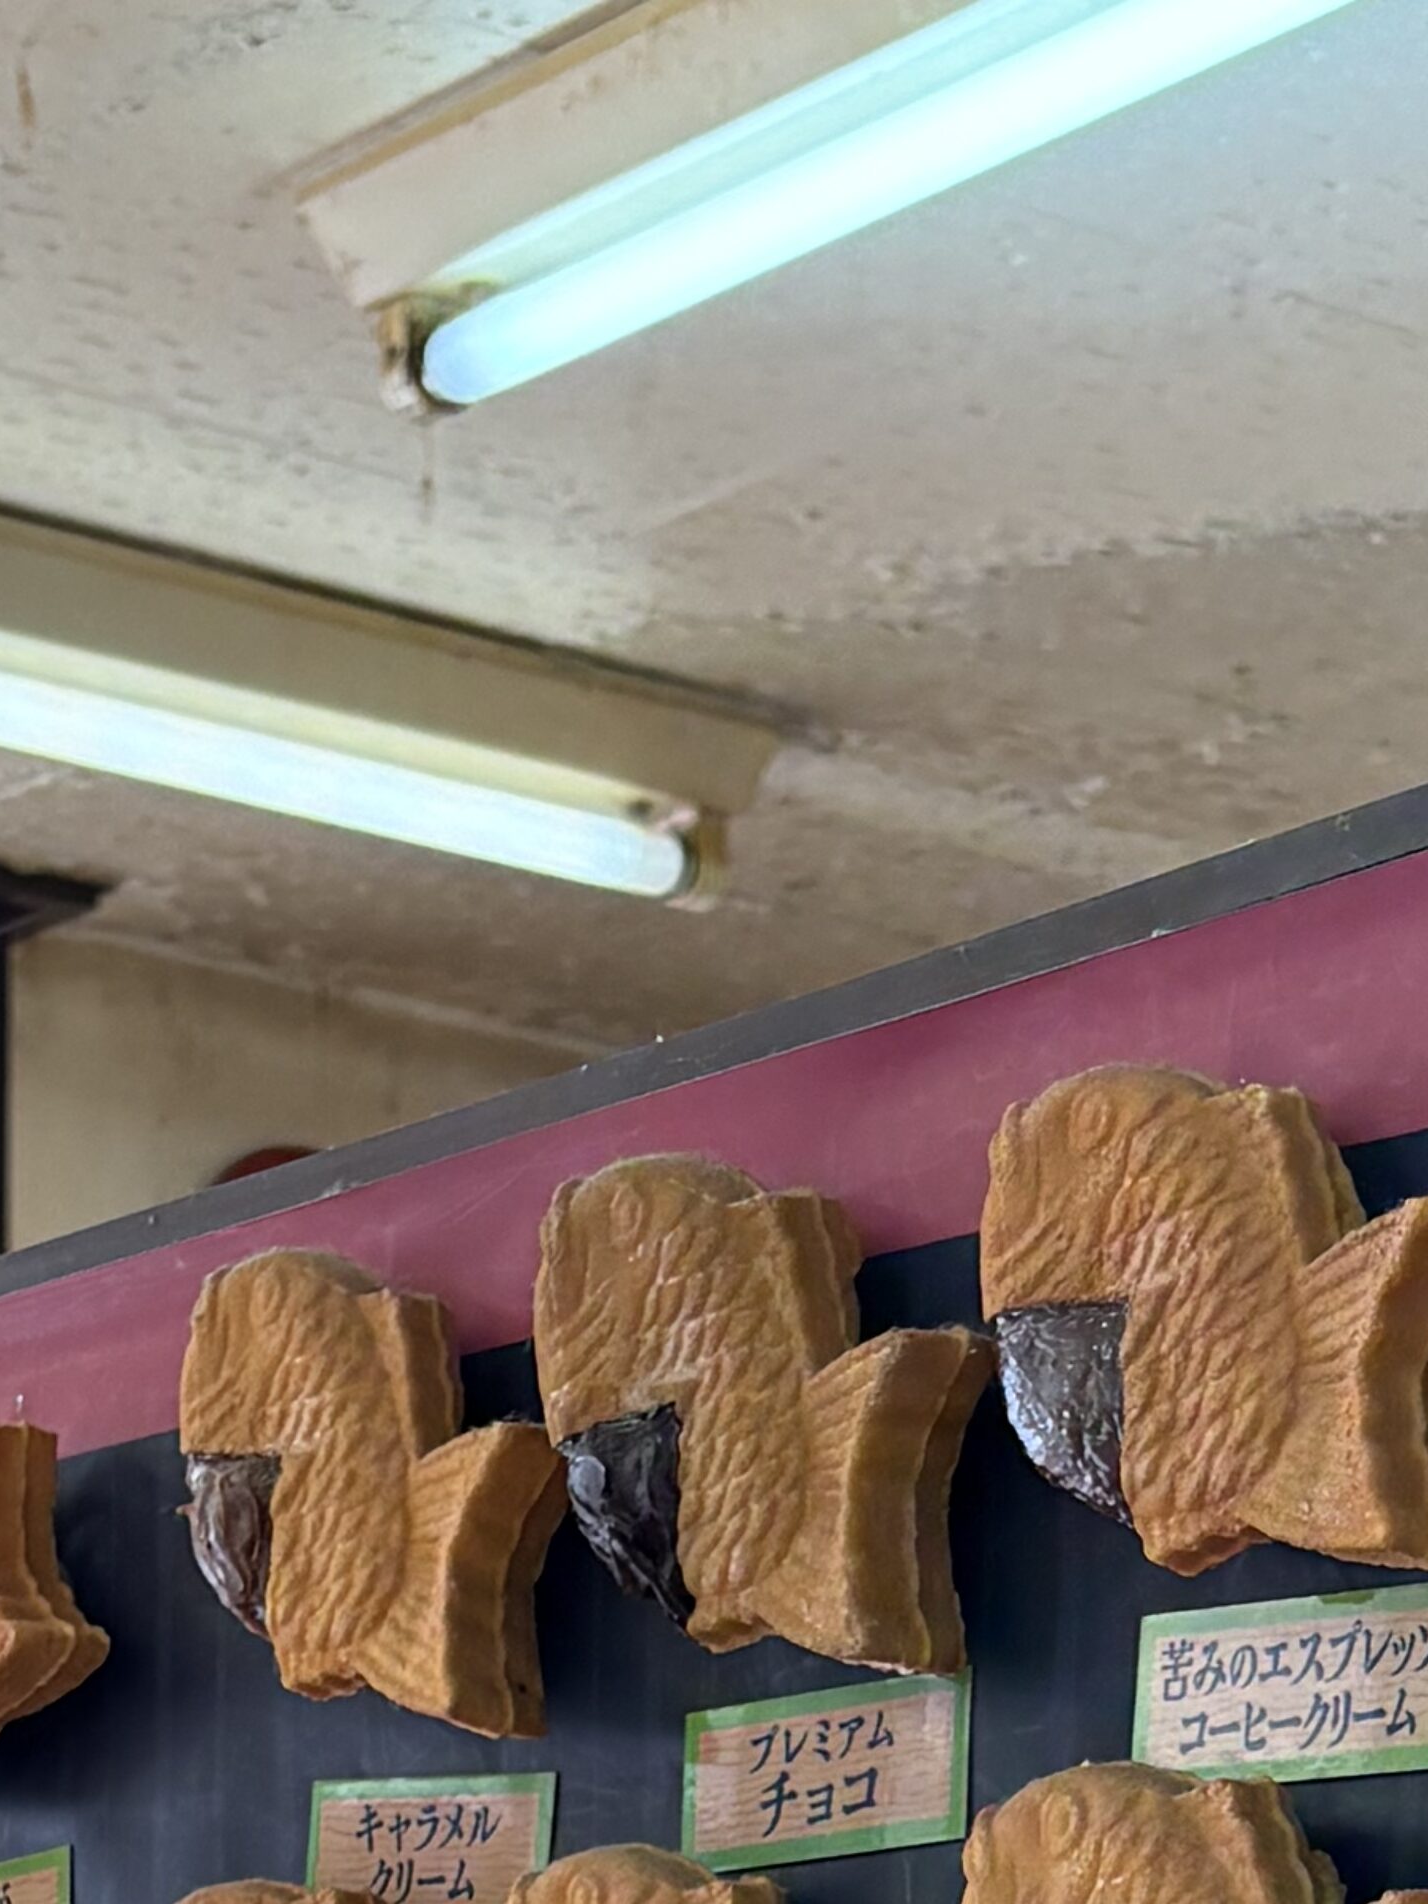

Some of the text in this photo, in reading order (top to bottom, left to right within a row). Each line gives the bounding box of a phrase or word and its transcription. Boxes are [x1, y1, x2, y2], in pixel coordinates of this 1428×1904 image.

[750, 1710, 895, 1773] プレミアム
[1179, 1688, 1416, 1755] コーヒークリーム
[356, 1803, 500, 1854] キャラメル
[761, 1767, 879, 1837] チョコ
[371, 1858, 475, 1904] クリーム
